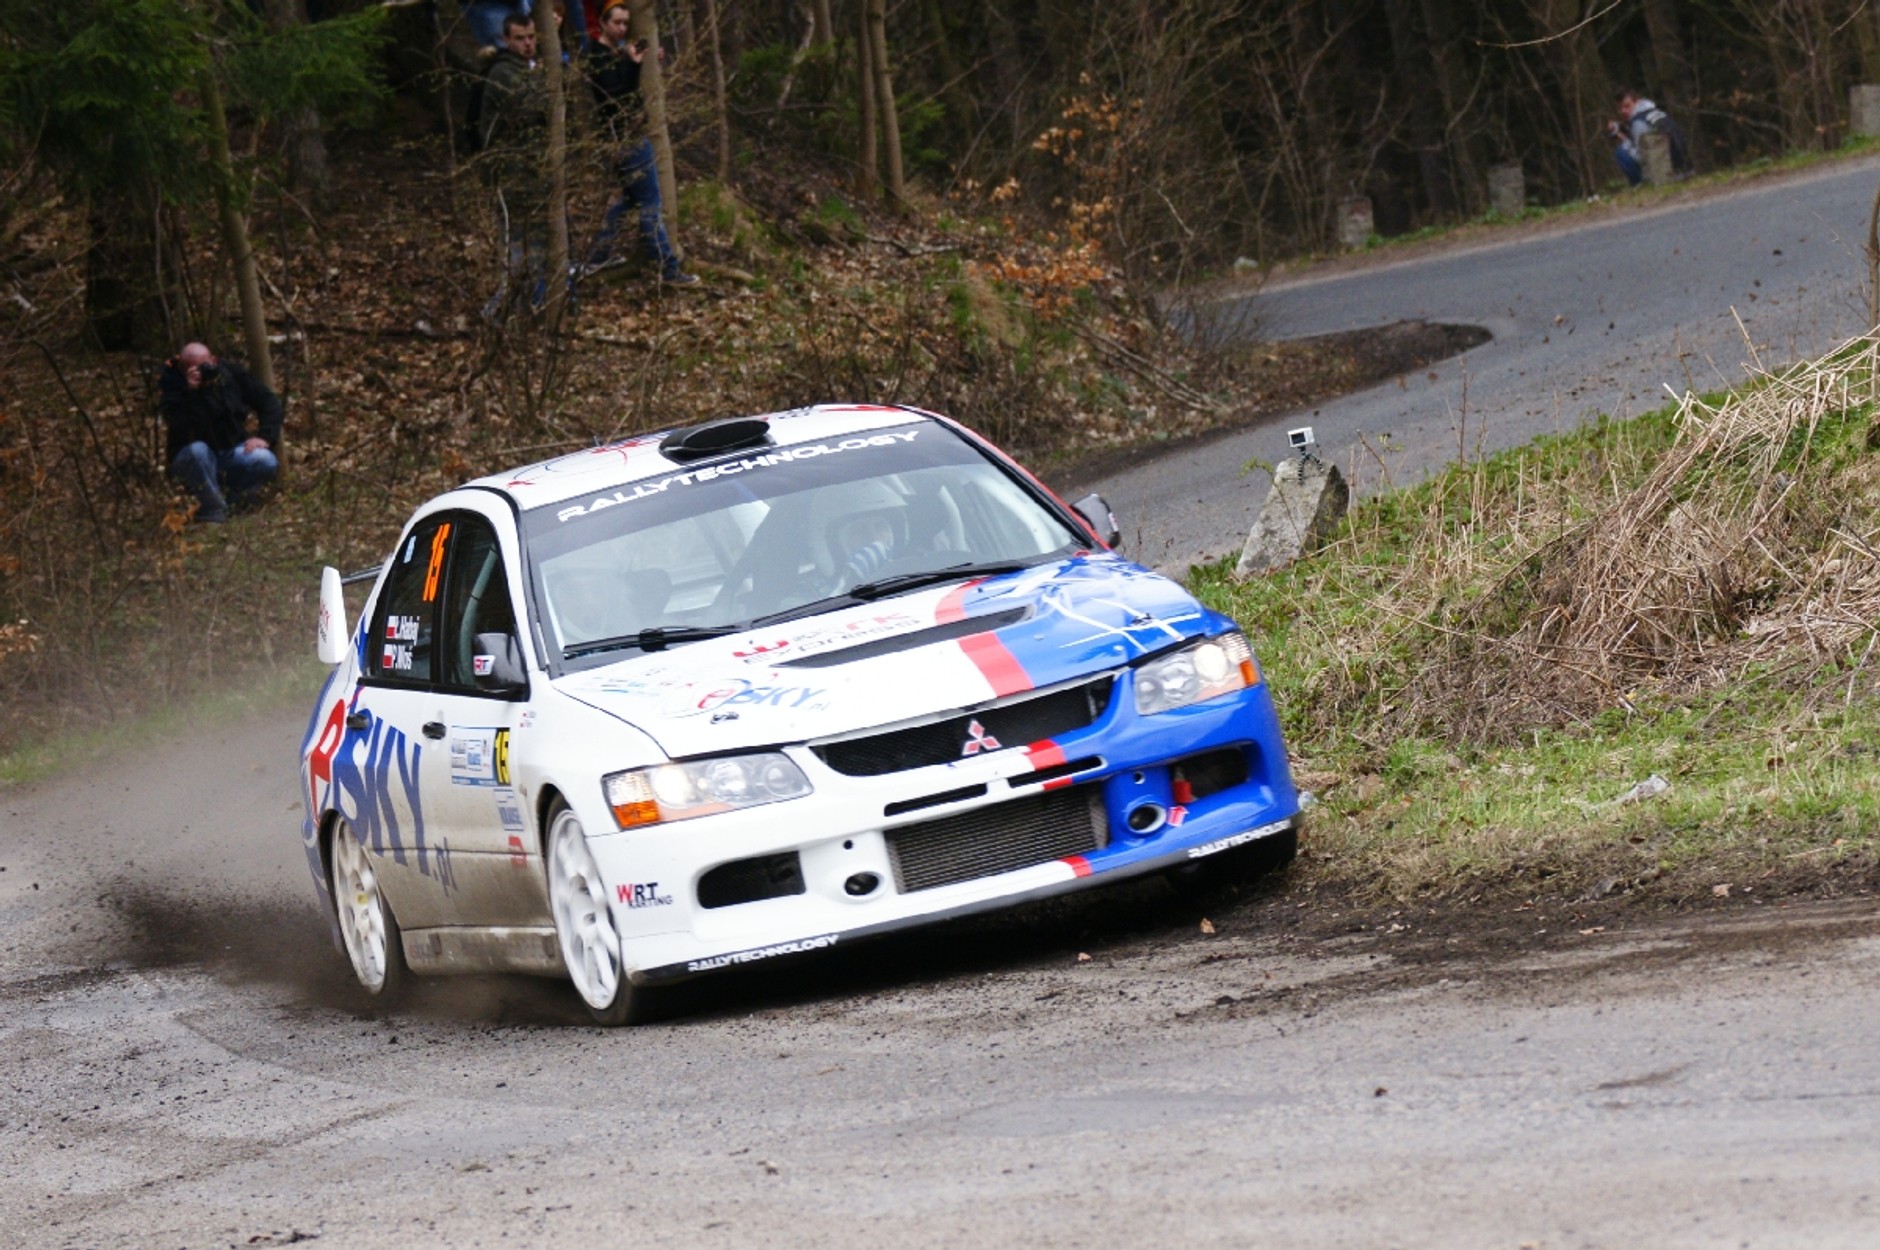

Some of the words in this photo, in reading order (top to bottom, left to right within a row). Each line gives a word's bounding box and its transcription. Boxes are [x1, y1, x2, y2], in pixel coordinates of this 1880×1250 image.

[557, 431, 920, 523] RALLYTECHNOLOGY
[616, 882, 658, 904] WRT
[687, 934, 840, 973] RALLYTECHNOLOGY
